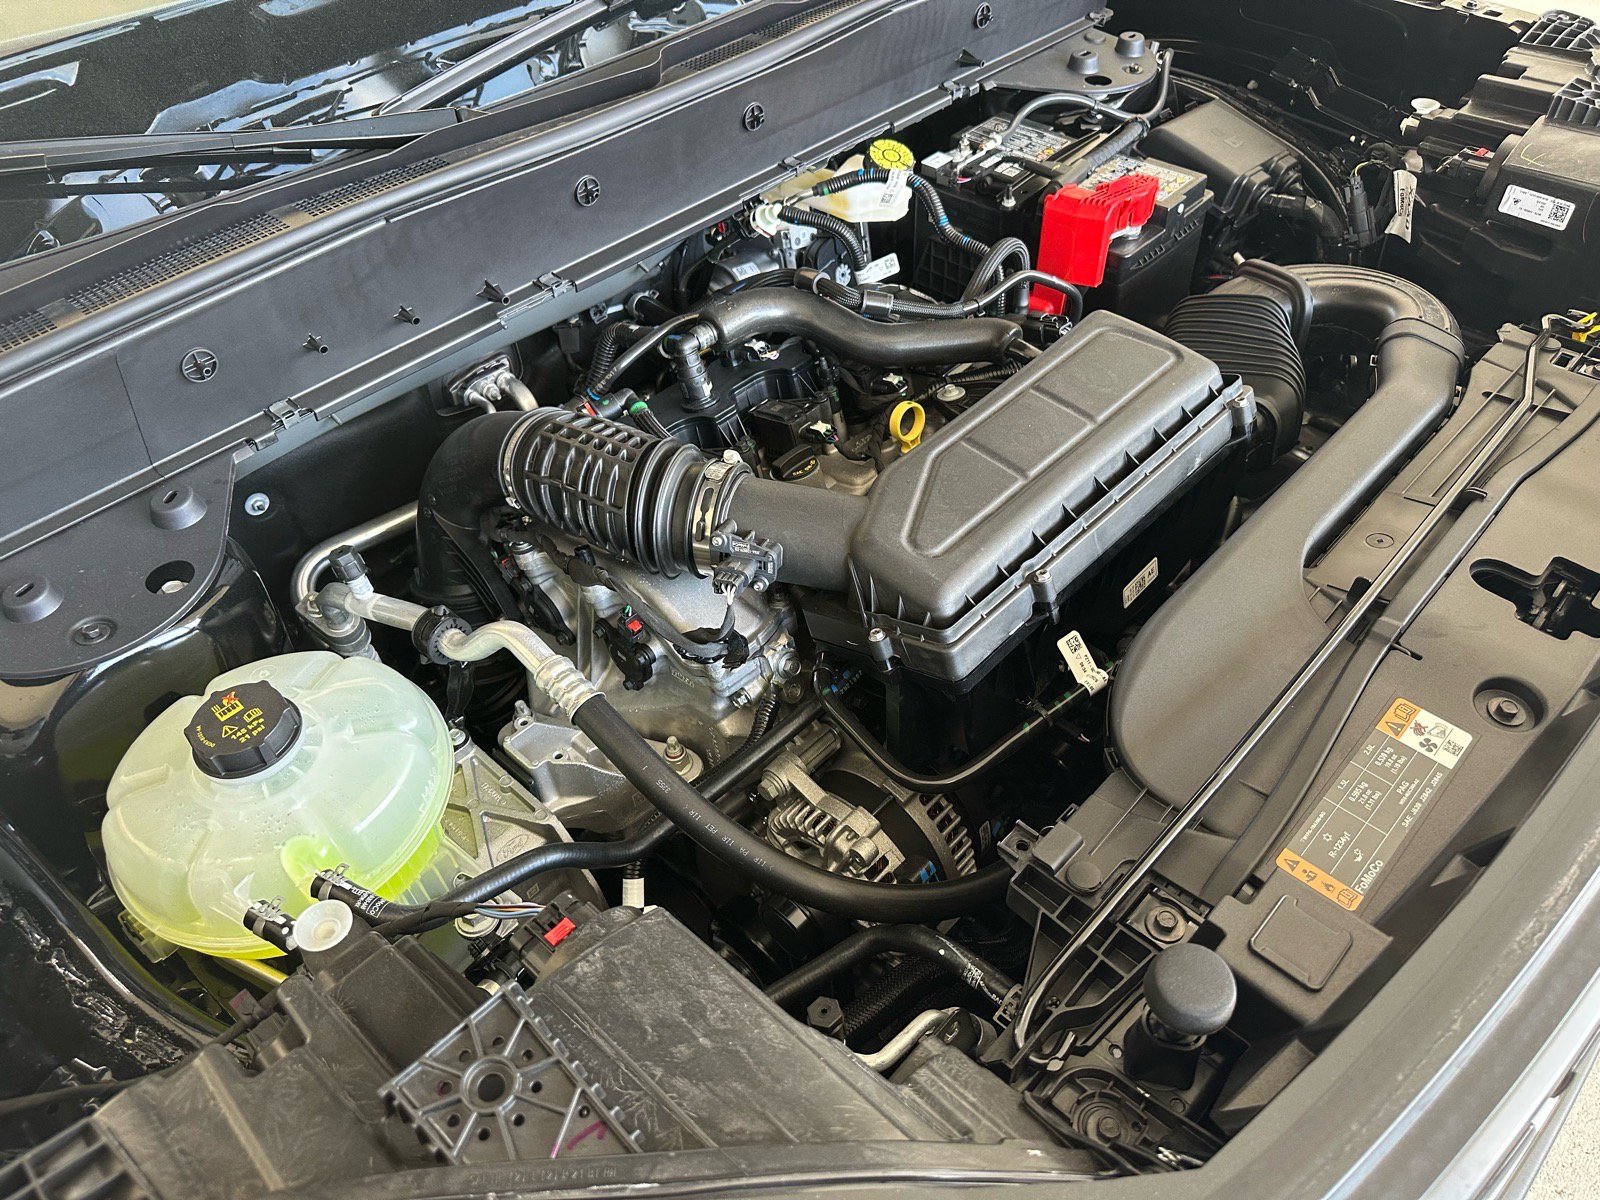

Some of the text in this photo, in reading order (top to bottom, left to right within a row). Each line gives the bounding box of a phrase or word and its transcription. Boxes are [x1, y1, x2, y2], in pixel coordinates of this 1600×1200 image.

[230, 718, 264, 739] 145 kPa
[238, 724, 265, 742] 21 psi
[1336, 776, 1350, 790] 1.5L
[1395, 780, 1409, 795] PAG
[704, 822, 718, 834] PET
[1401, 814, 1413, 827] SAE
[1327, 830, 1351, 858] R-1234yf
[1353, 859, 1384, 894] FoMoCo
